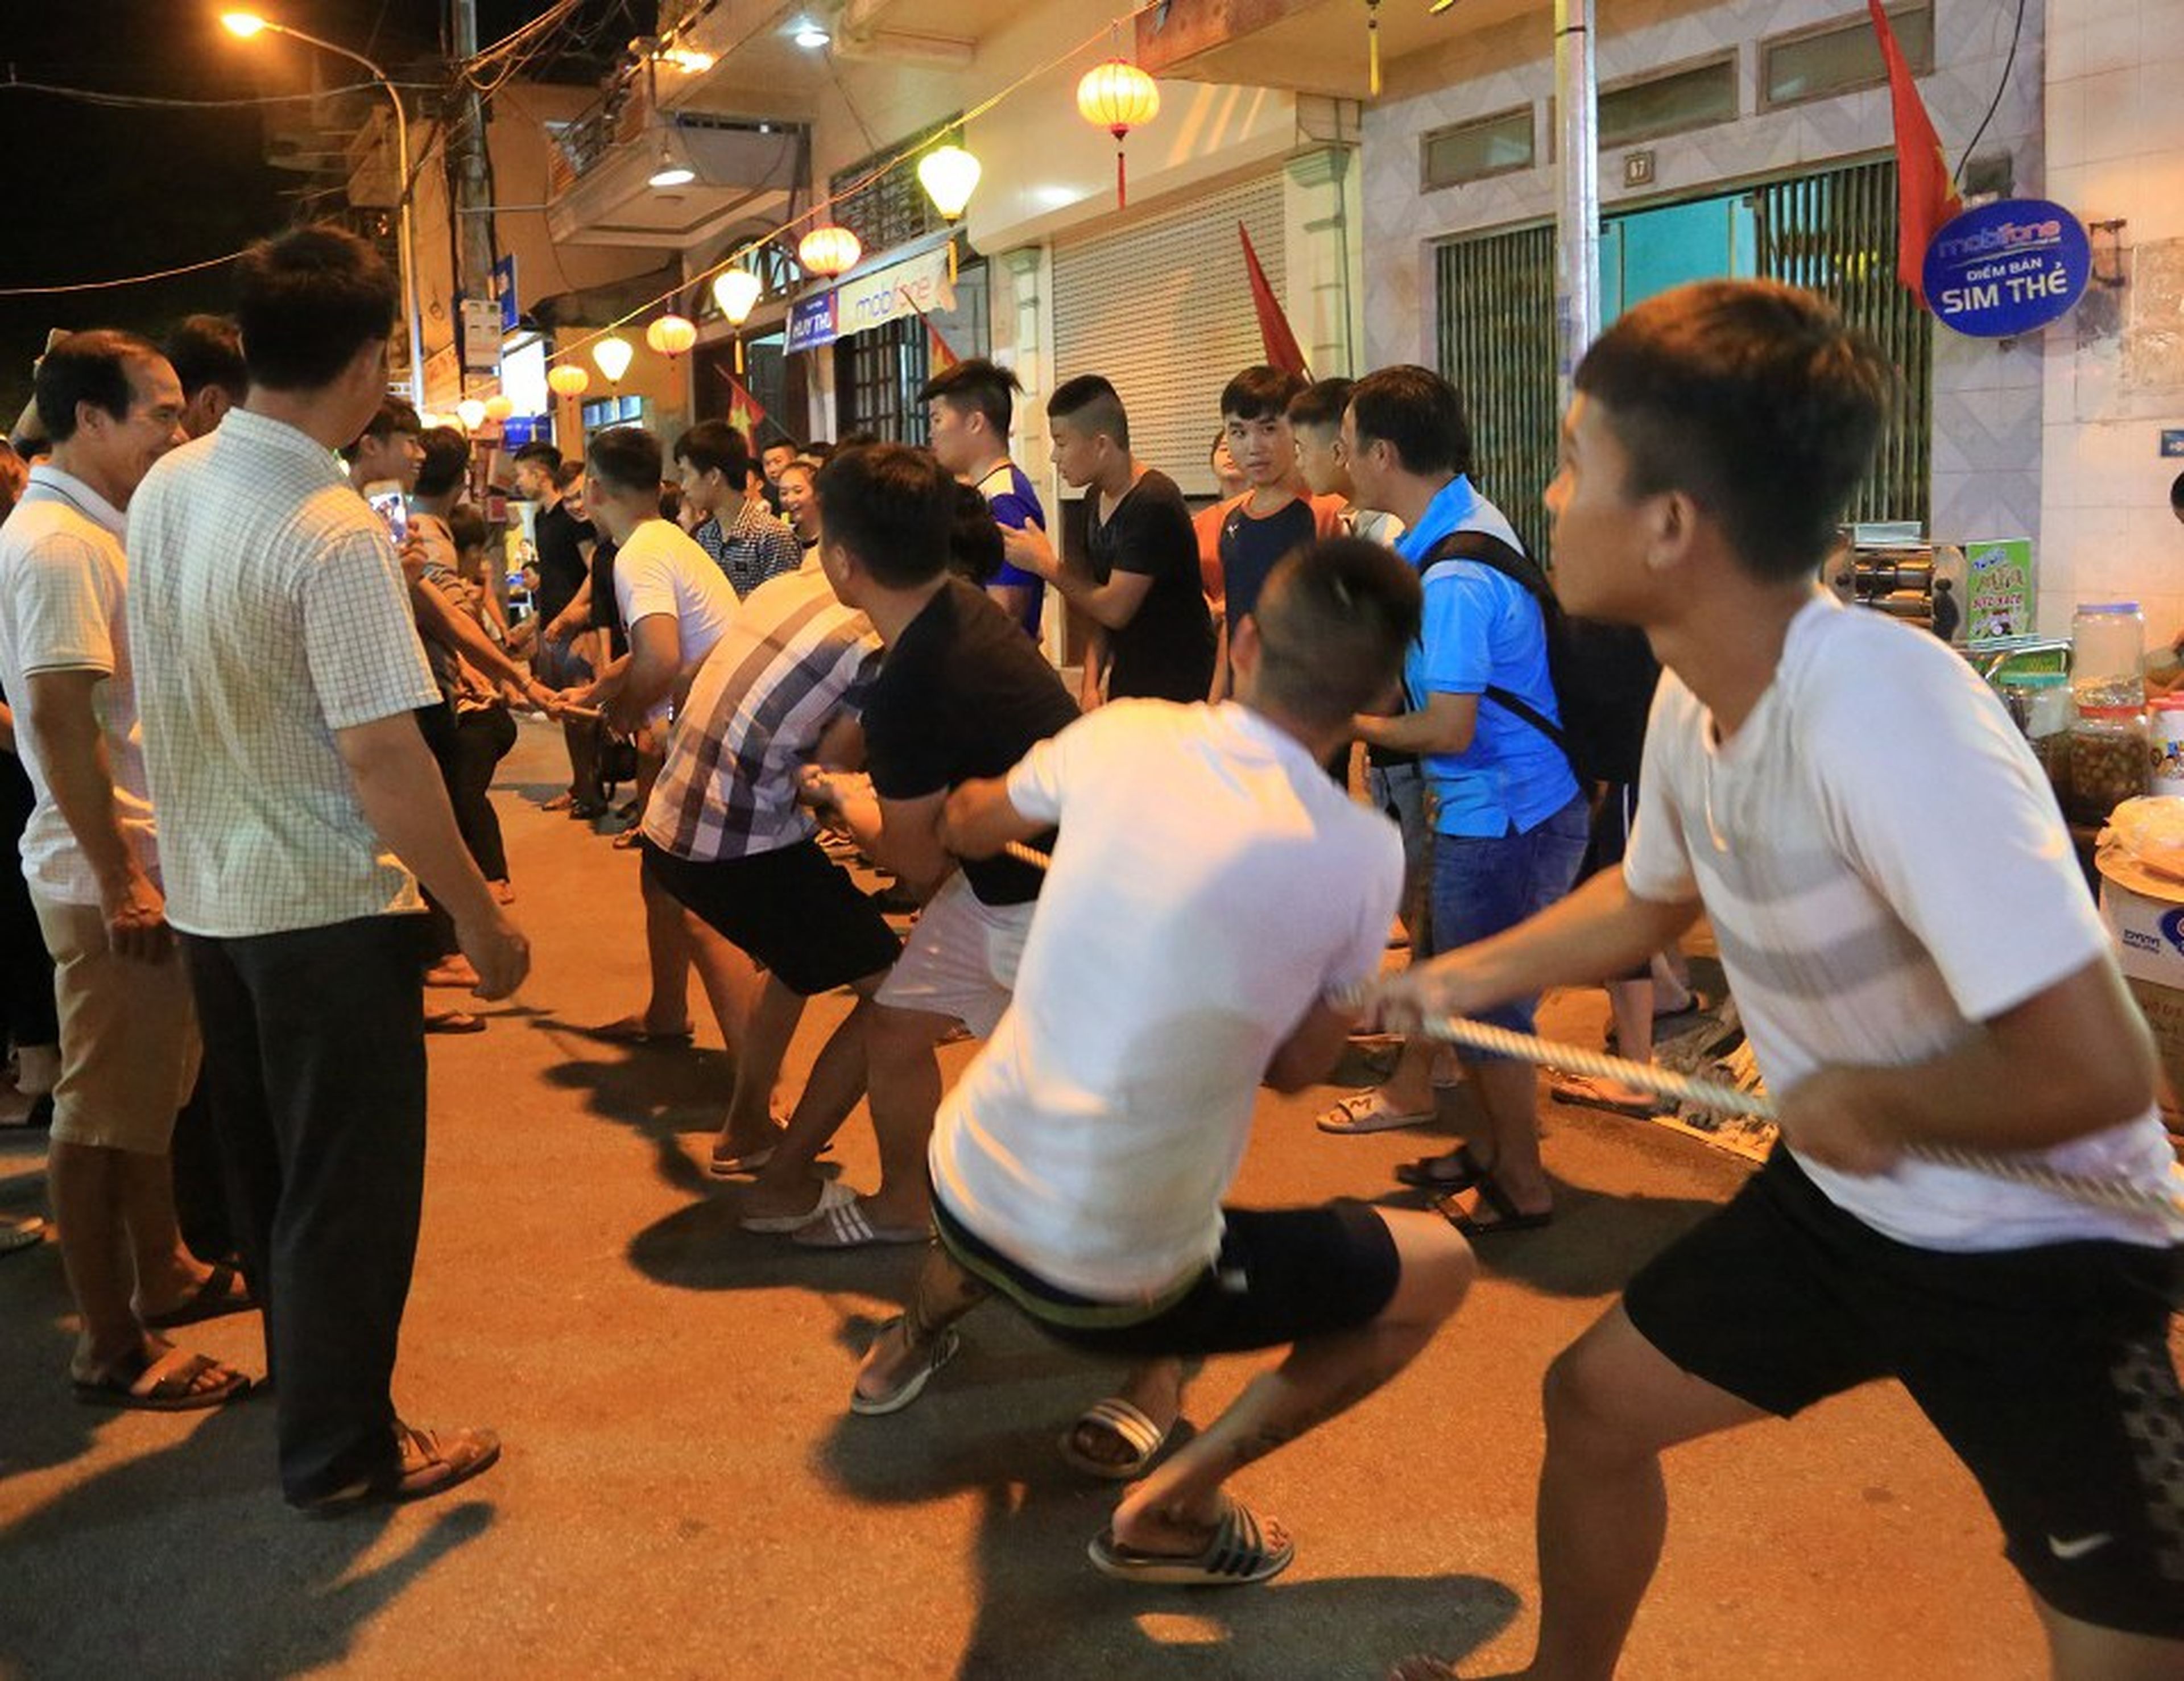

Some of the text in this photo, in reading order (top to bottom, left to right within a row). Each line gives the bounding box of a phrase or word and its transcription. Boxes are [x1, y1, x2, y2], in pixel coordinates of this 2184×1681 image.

[1941, 221, 2061, 256] mobifone
[1941, 262, 2067, 313] SIM THẺ
